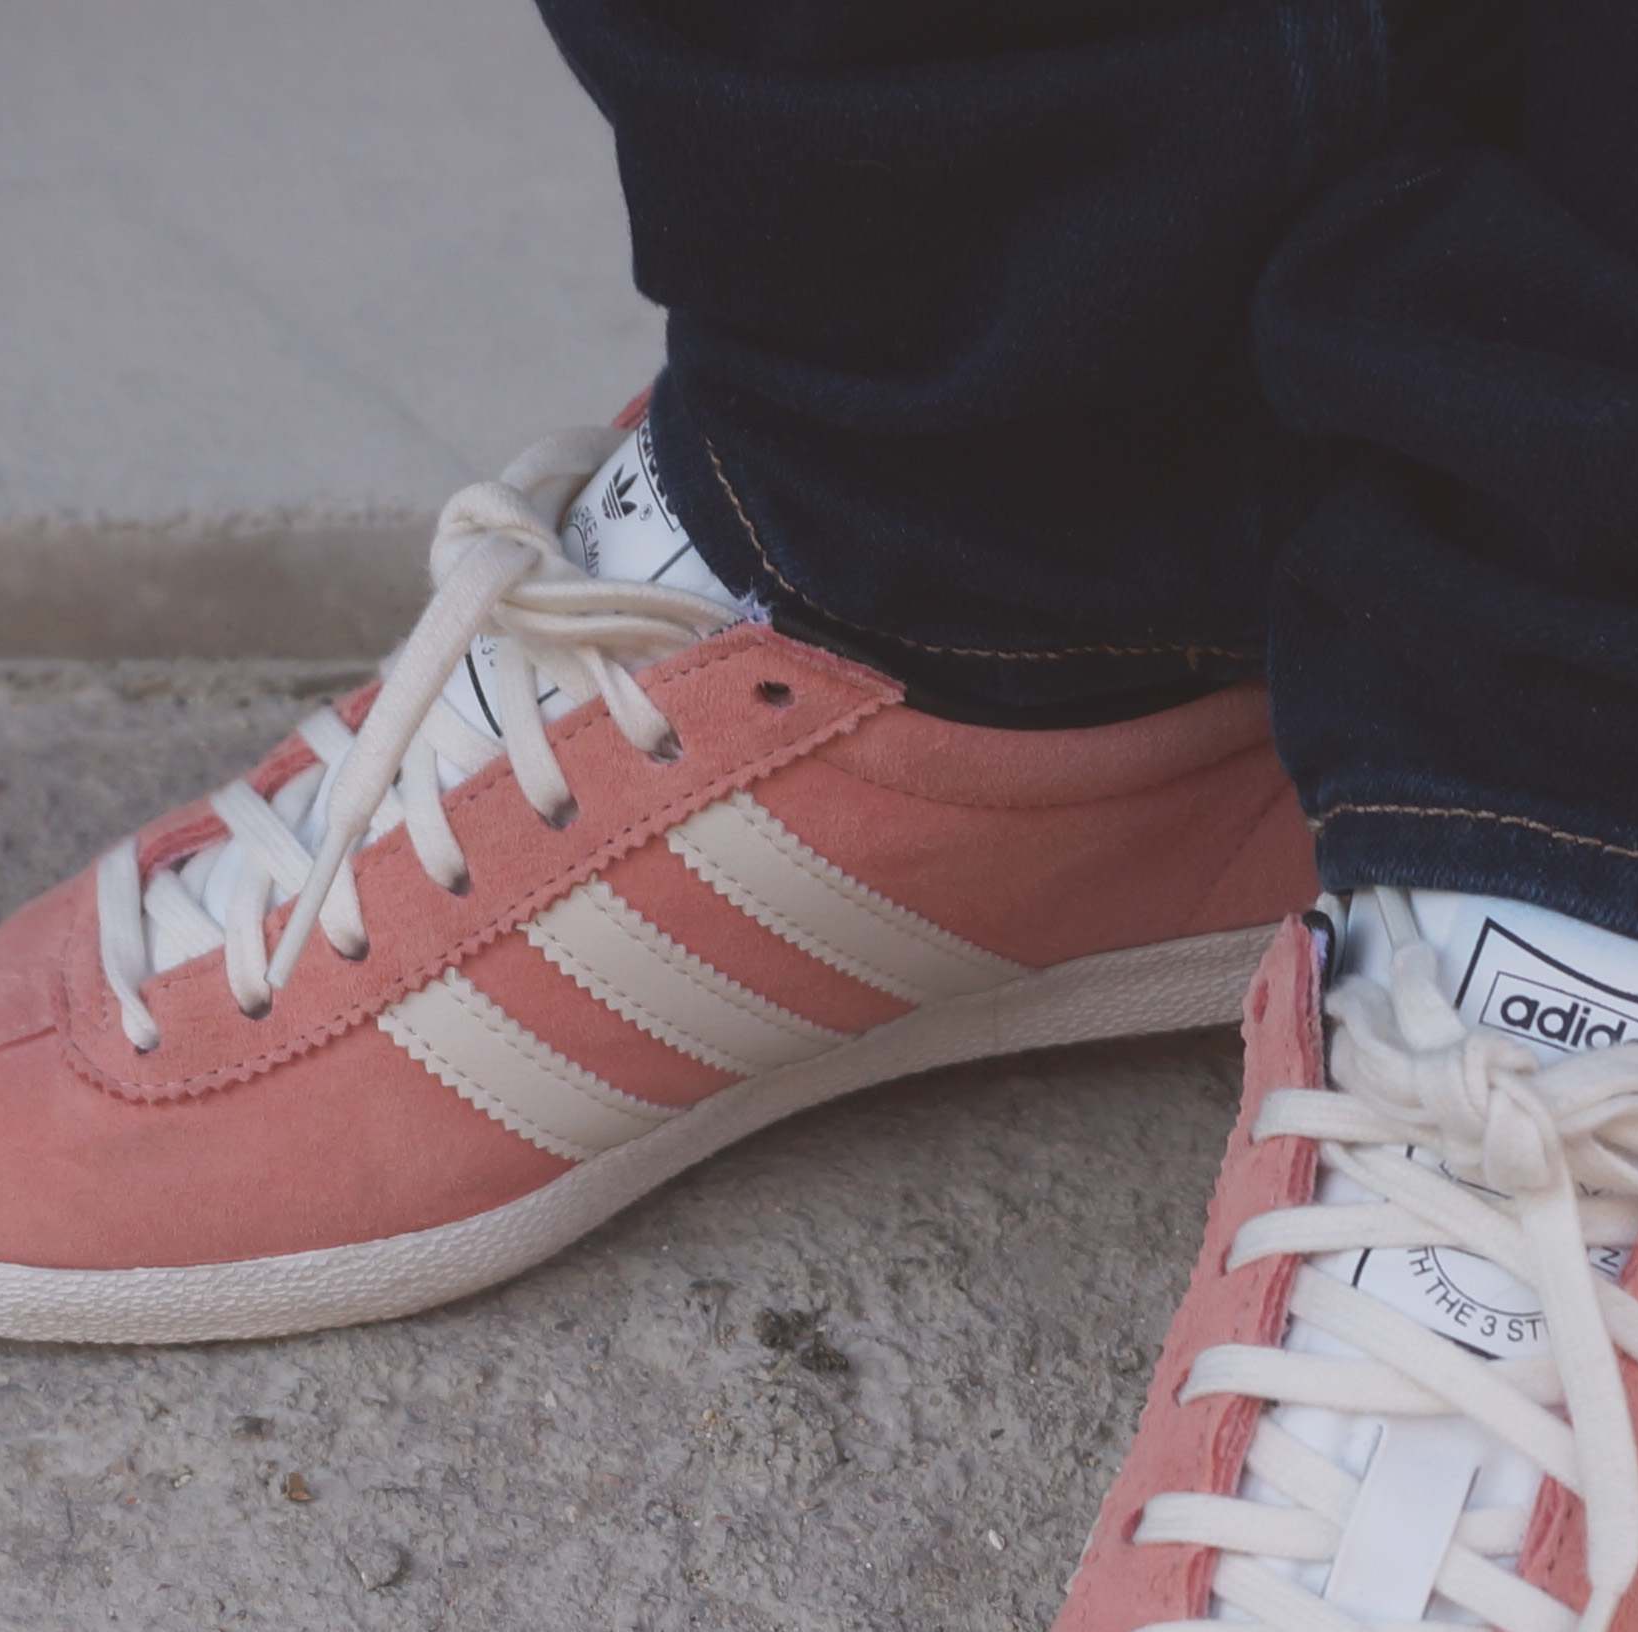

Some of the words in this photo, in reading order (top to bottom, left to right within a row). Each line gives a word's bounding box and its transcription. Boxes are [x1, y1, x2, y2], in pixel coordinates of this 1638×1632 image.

[1425, 1275, 1478, 1327] THE
[1479, 1314, 1498, 1337] 3
[1506, 1317, 1543, 1342] ST
